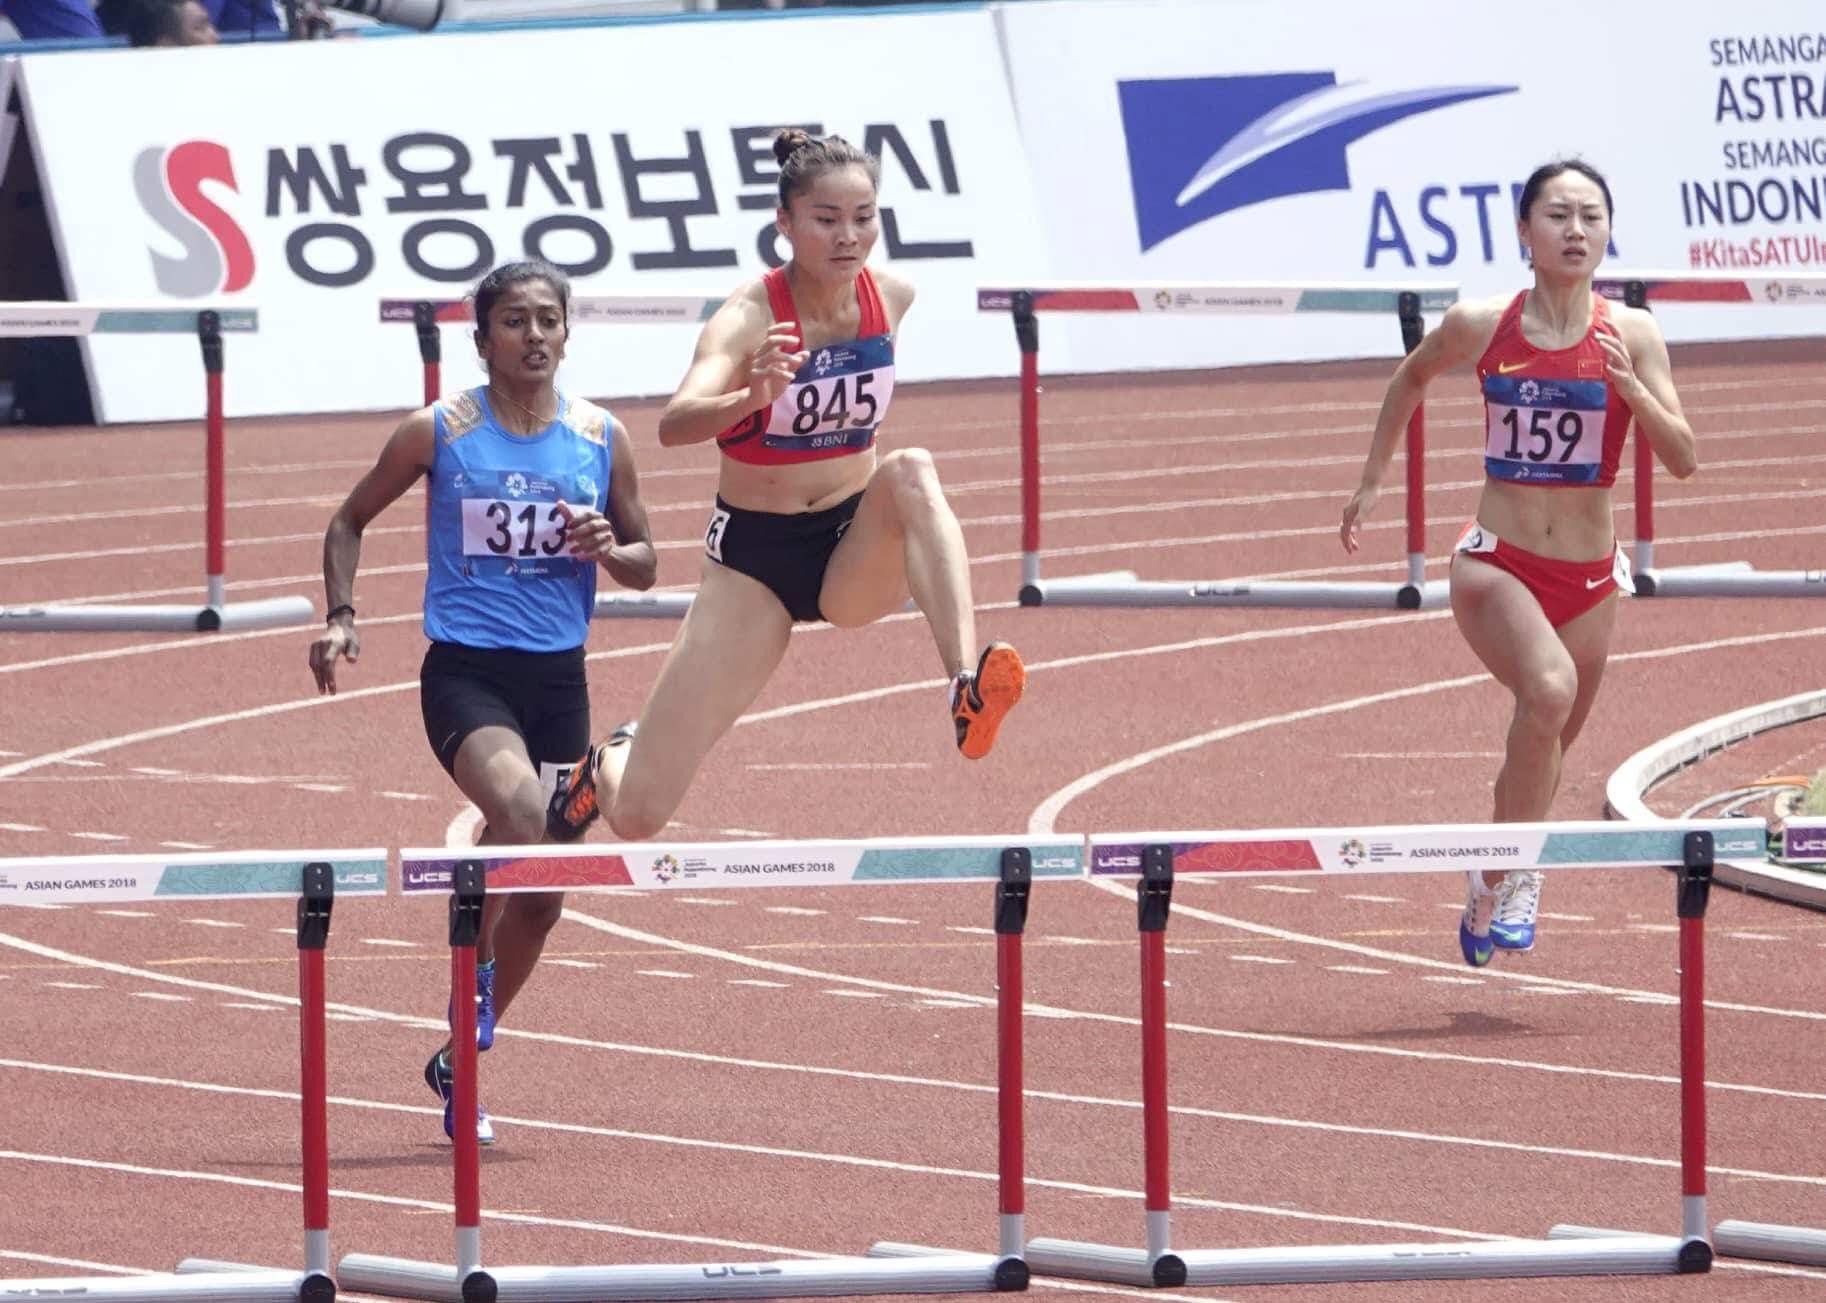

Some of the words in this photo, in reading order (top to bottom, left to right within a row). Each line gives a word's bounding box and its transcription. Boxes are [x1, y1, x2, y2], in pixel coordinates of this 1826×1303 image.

[1715, 74, 1826, 123] ASTR
[1681, 176, 1826, 228] INDON
[1365, 183, 1619, 268] AST
[792, 373, 877, 435] 845
[823, 433, 849, 447] BNI
[1502, 408, 1583, 463] 159
[486, 501, 569, 557] 313
[1098, 856, 1141, 867] UCS
[1410, 848, 1446, 858] ASIAN
[1448, 847, 1489, 857] GAMES
[1491, 846, 1519, 856] 2018
[409, 872, 452, 883] UCS
[724, 864, 760, 874] ASIAN
[763, 863, 805, 873] GAMES
[807, 862, 835, 872] 2018
[25, 881, 62, 891] ASIAN
[64, 879, 106, 889] GAMES
[108, 878, 136, 888] 2018
